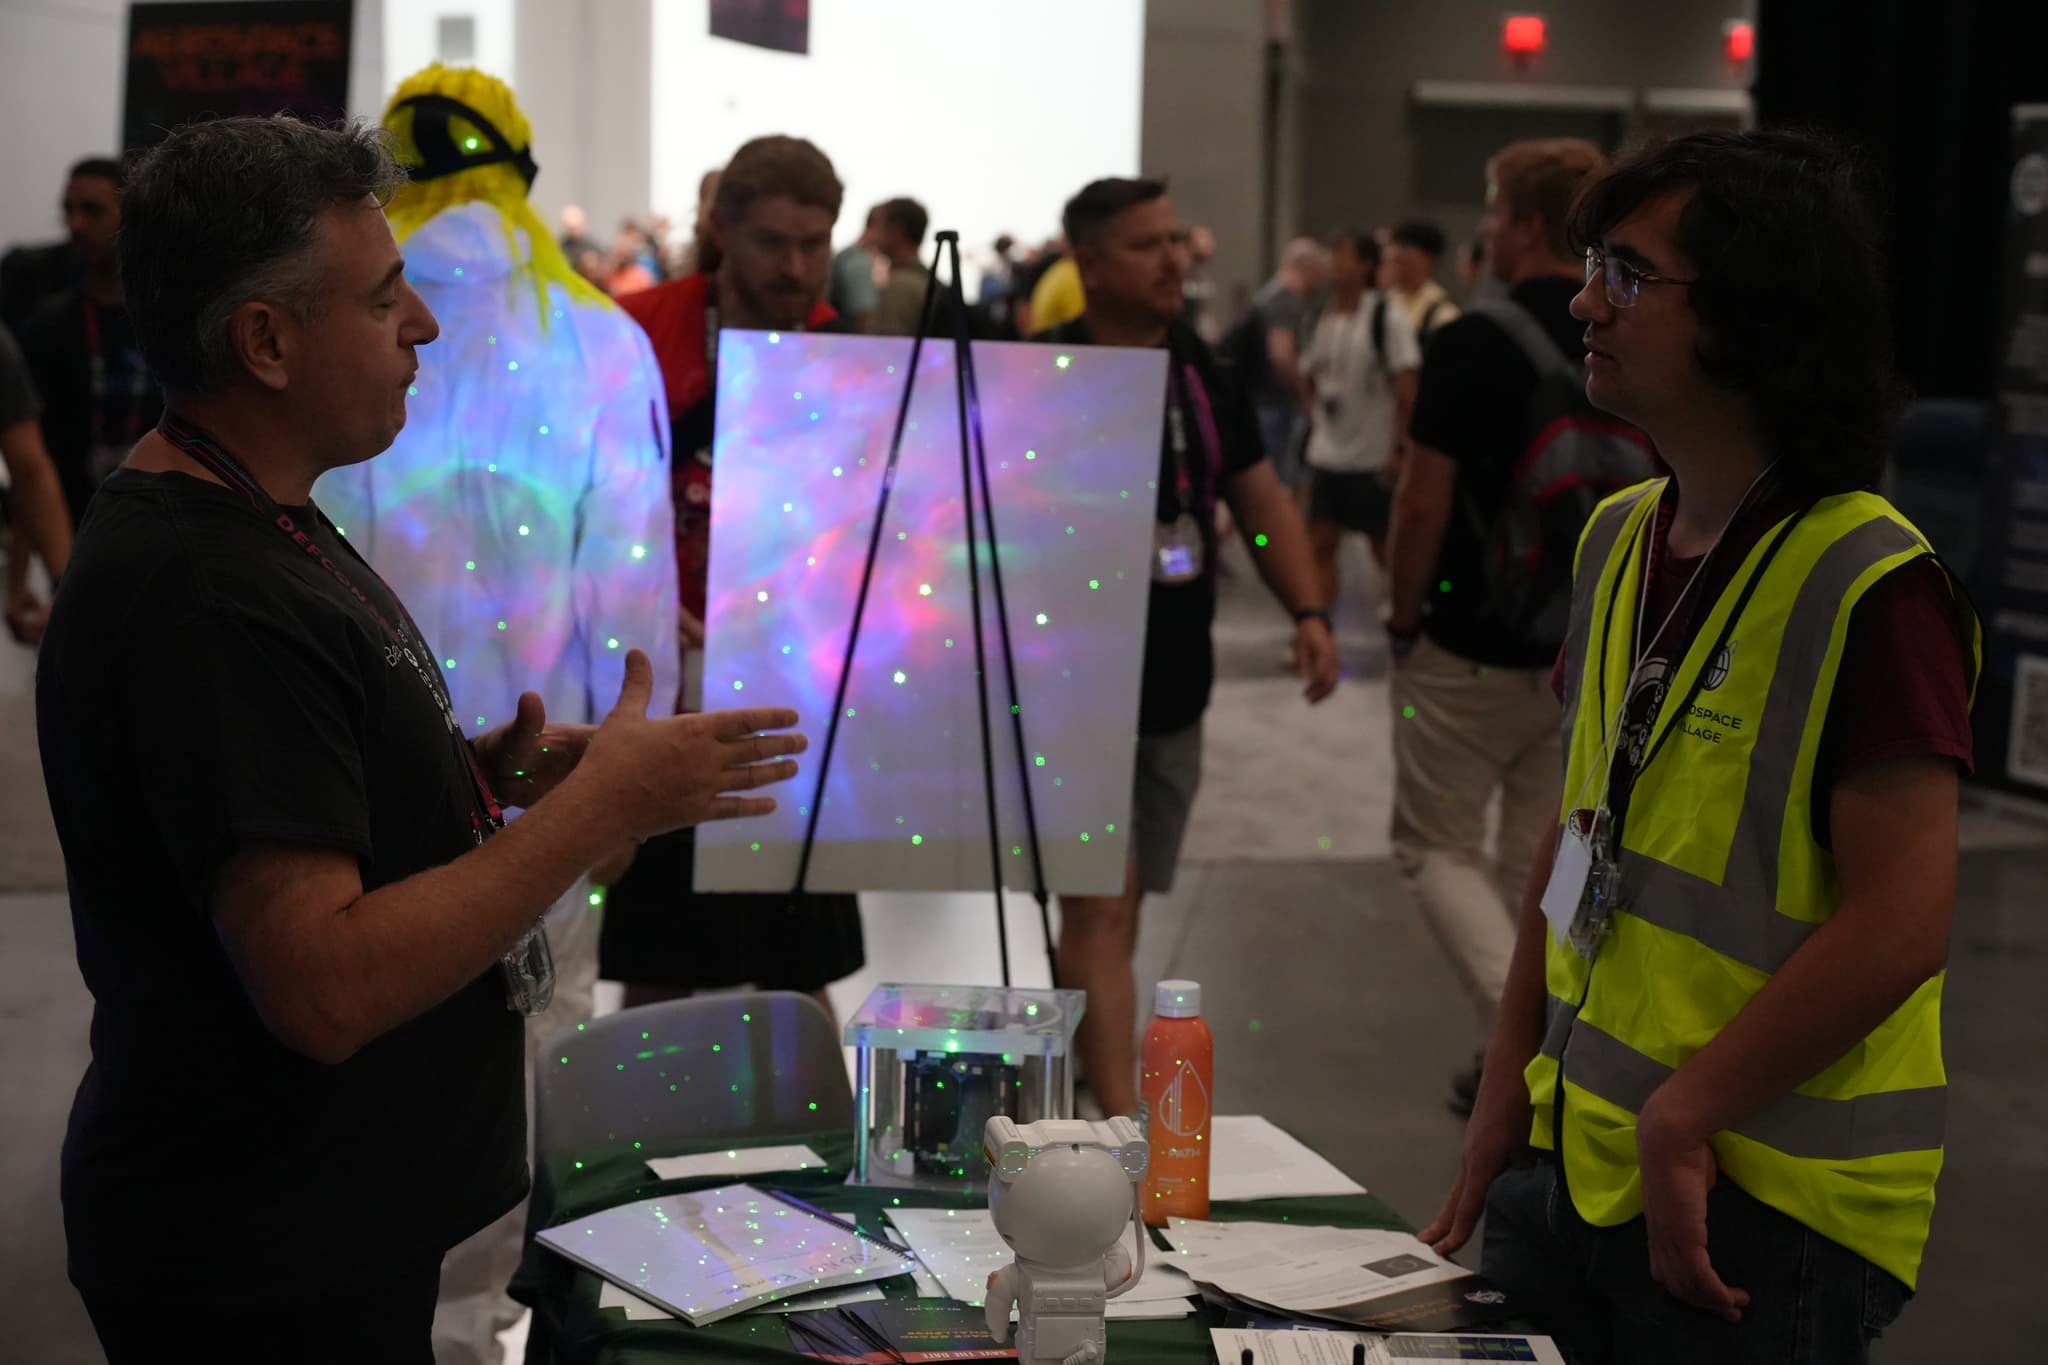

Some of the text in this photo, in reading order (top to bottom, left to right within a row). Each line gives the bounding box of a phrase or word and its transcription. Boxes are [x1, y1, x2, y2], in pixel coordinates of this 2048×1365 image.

[1687, 704, 1743, 730] OSPACE
[1679, 719, 1722, 744] ILLAGE
[1168, 1147, 1201, 1159] PATH
